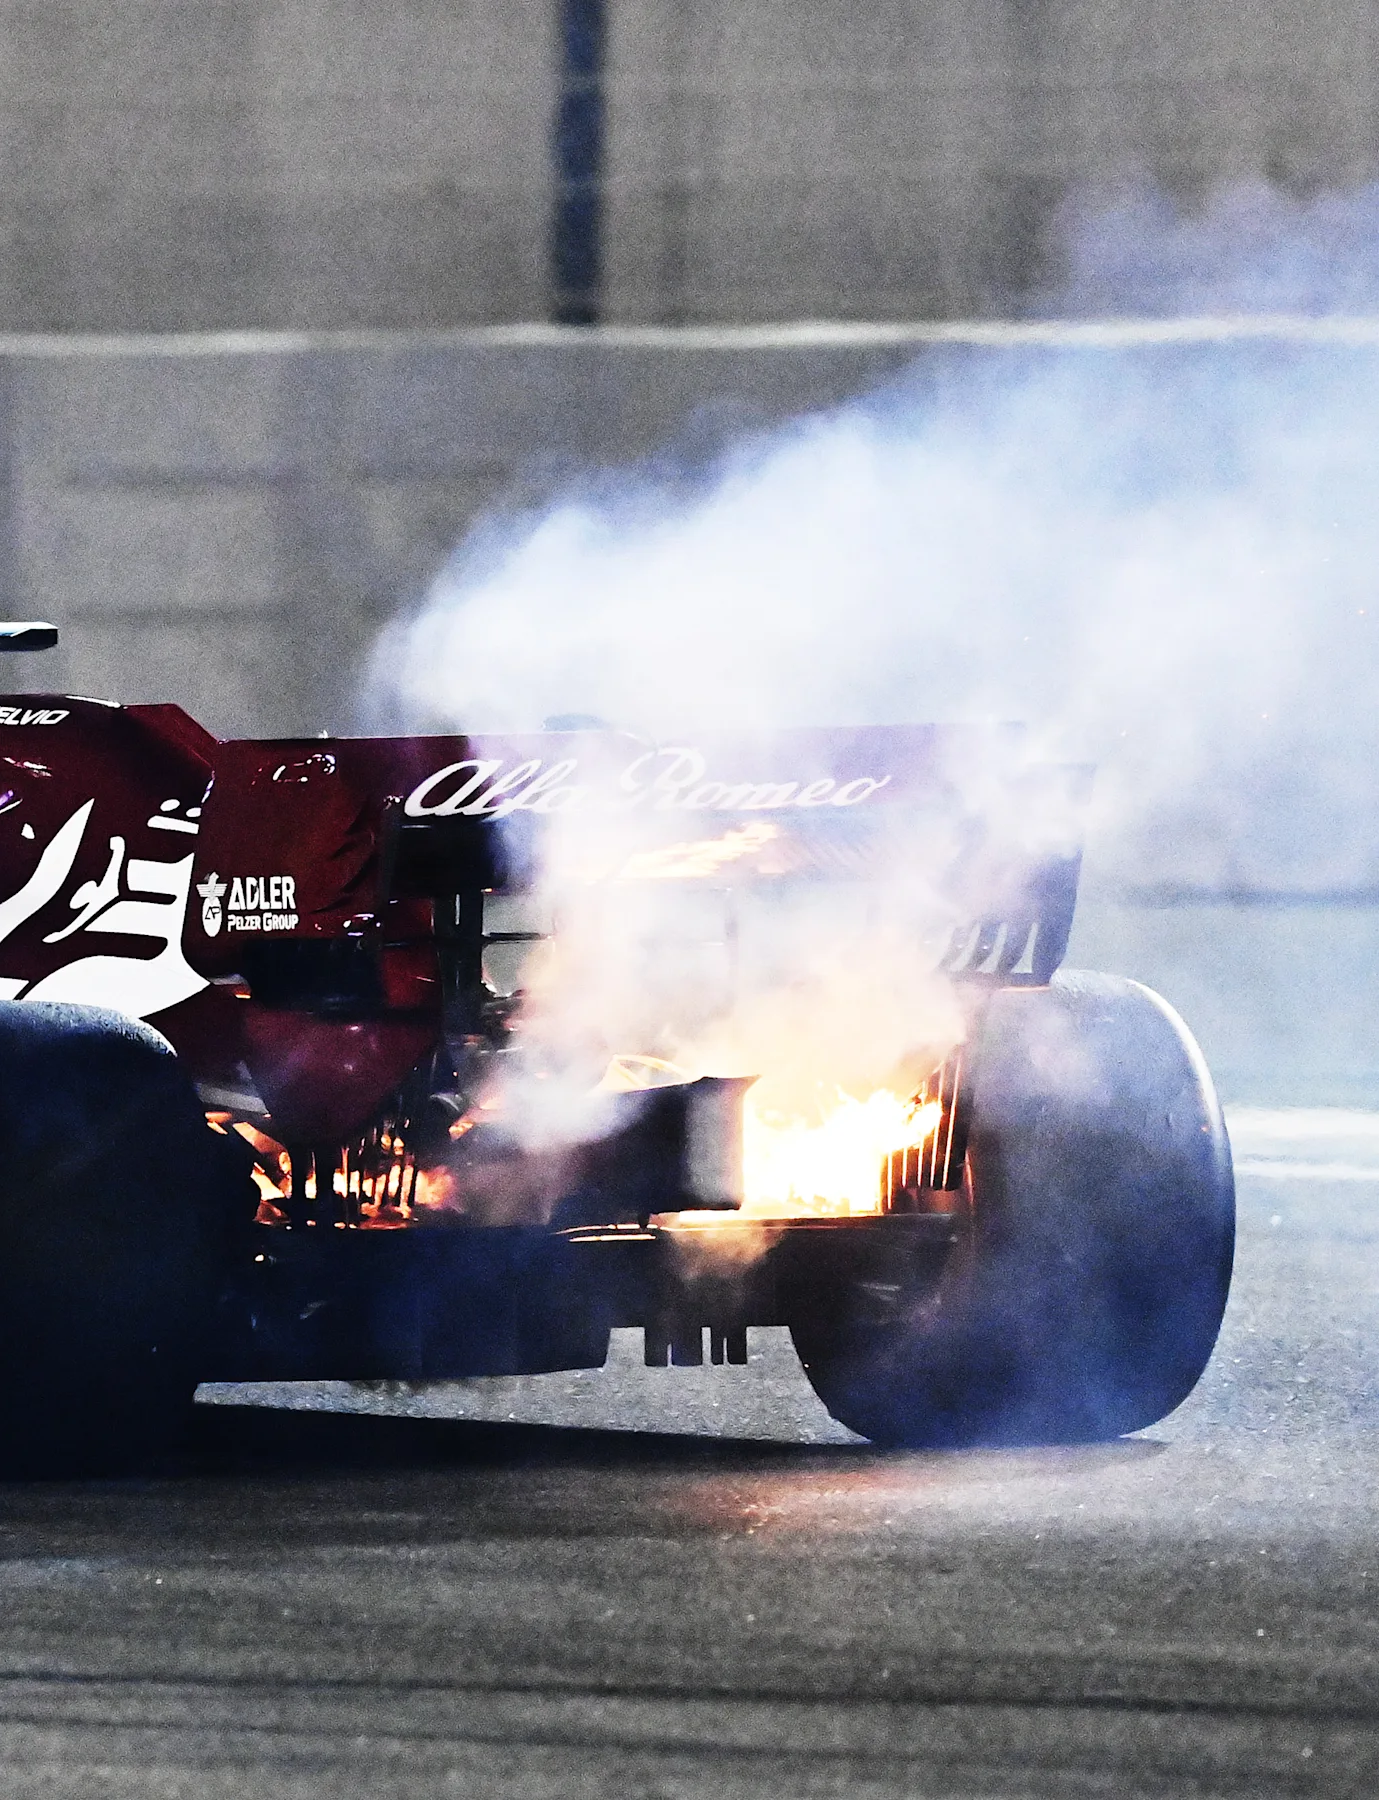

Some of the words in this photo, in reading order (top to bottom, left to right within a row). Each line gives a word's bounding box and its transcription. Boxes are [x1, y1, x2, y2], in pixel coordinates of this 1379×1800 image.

[404, 758, 592, 821] Alfa
[620, 746, 892, 812] Romeo
[228, 876, 296, 910] ADLER
[228, 914, 261, 932] PELZER
[263, 912, 299, 931] GROUP
